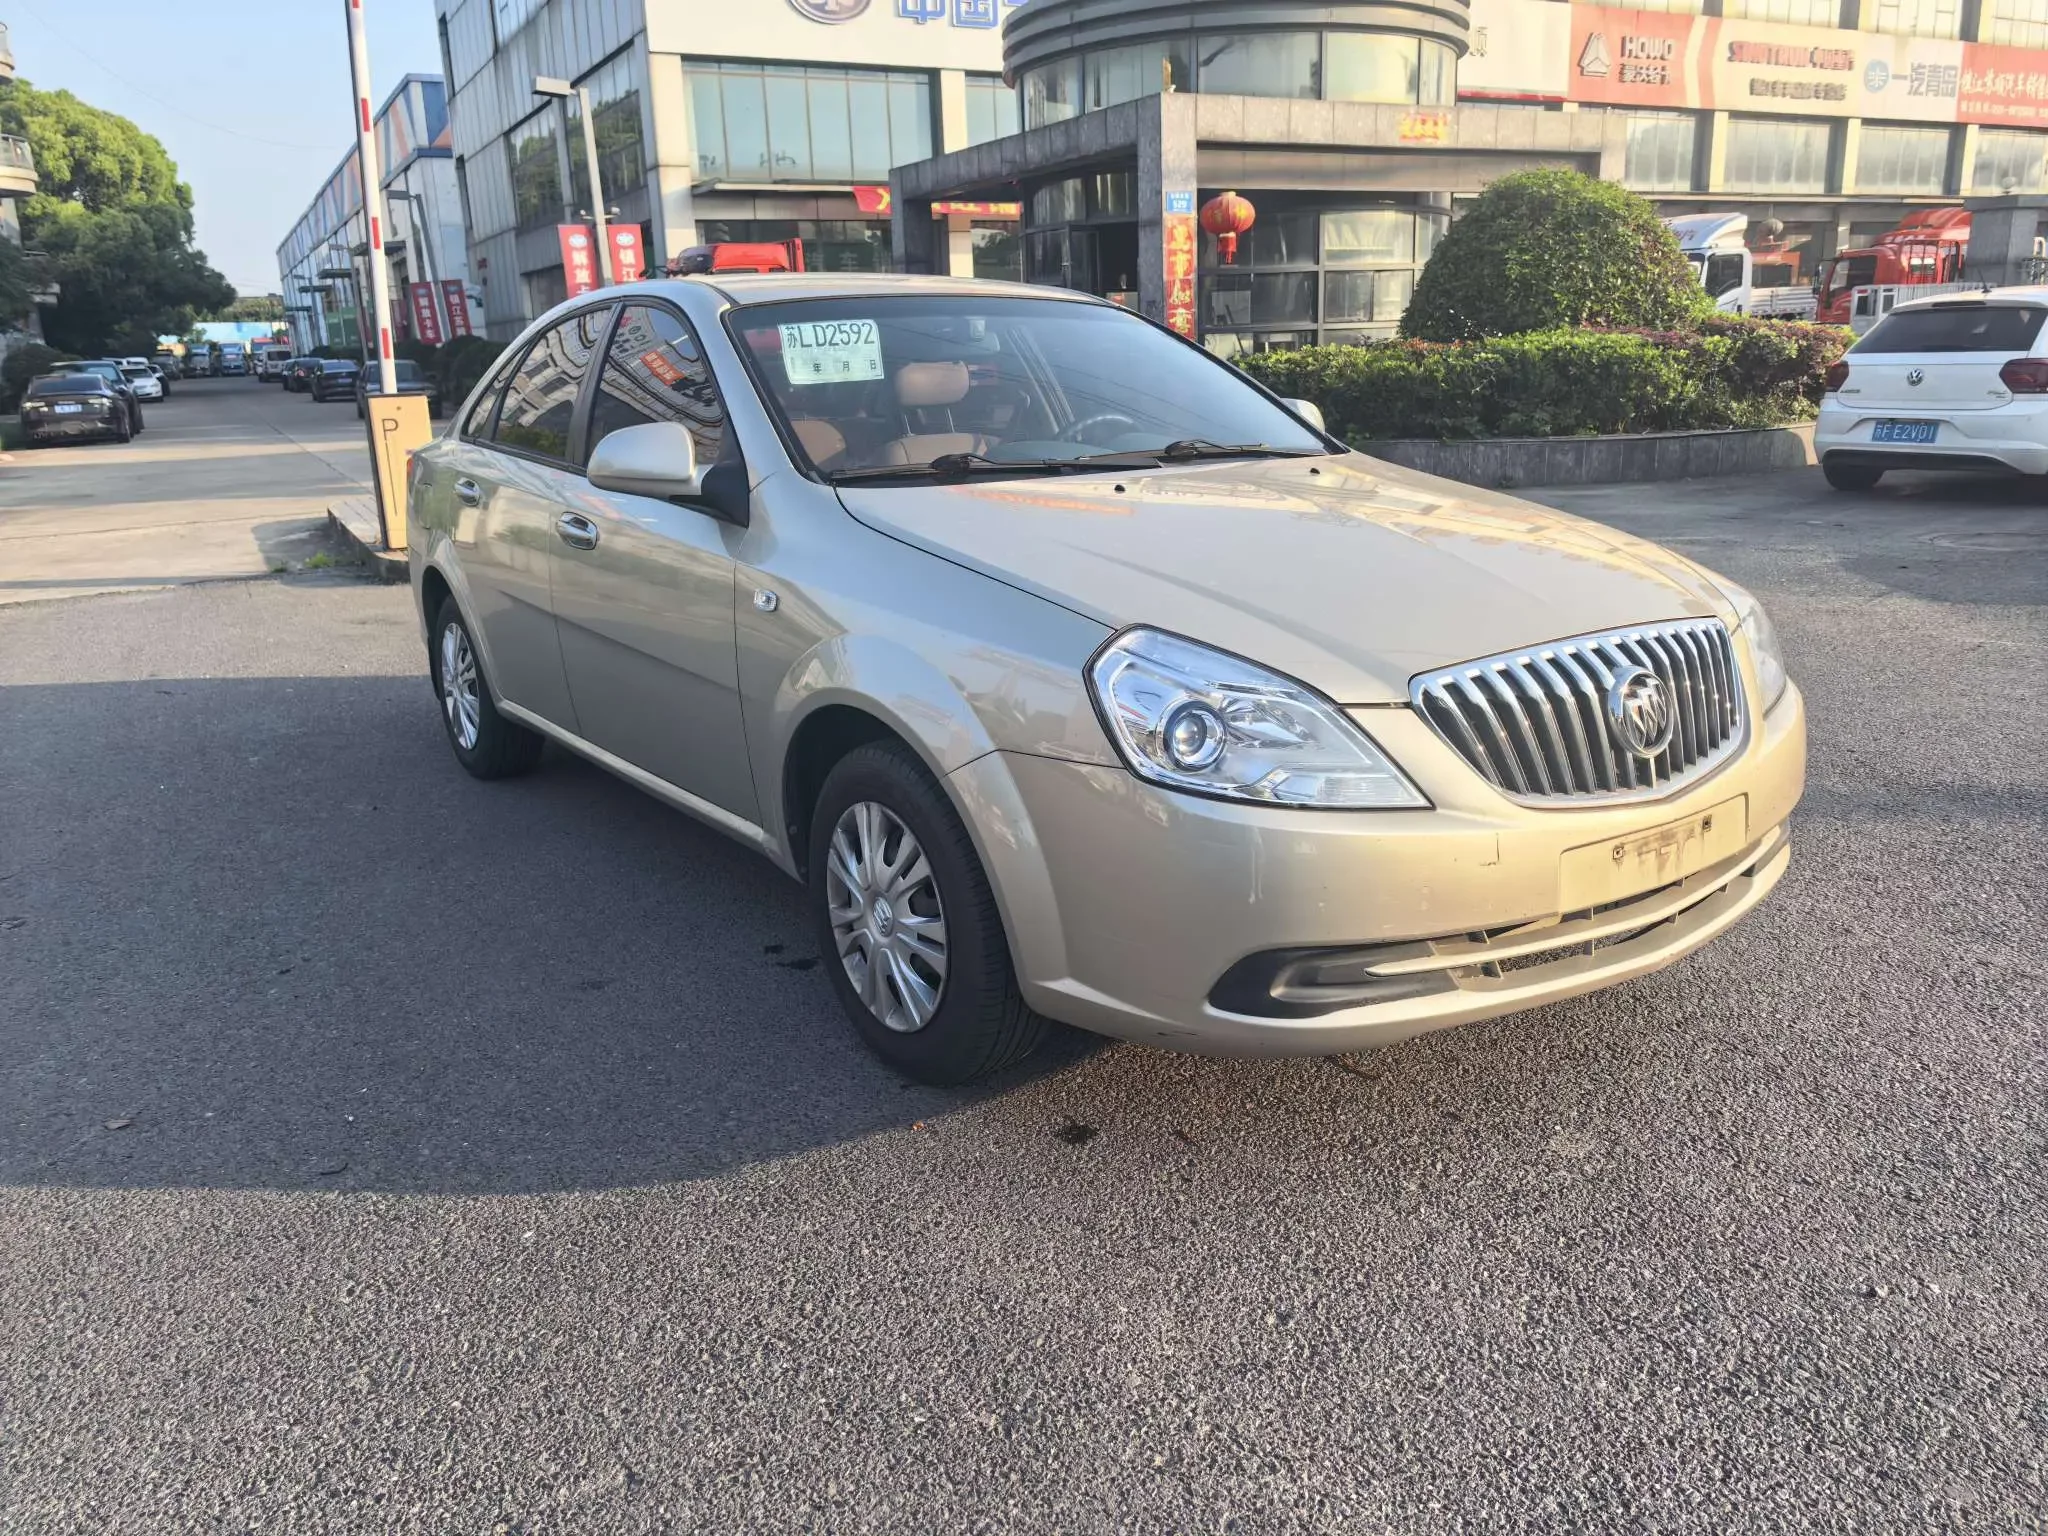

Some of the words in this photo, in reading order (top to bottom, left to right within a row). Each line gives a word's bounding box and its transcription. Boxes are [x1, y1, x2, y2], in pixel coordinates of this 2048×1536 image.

[1620, 35, 1676, 61] HOWO
[785, 322, 875, 349] 苏LD2592
[842, 361, 850, 372] 月
[869, 359, 877, 371] 日
